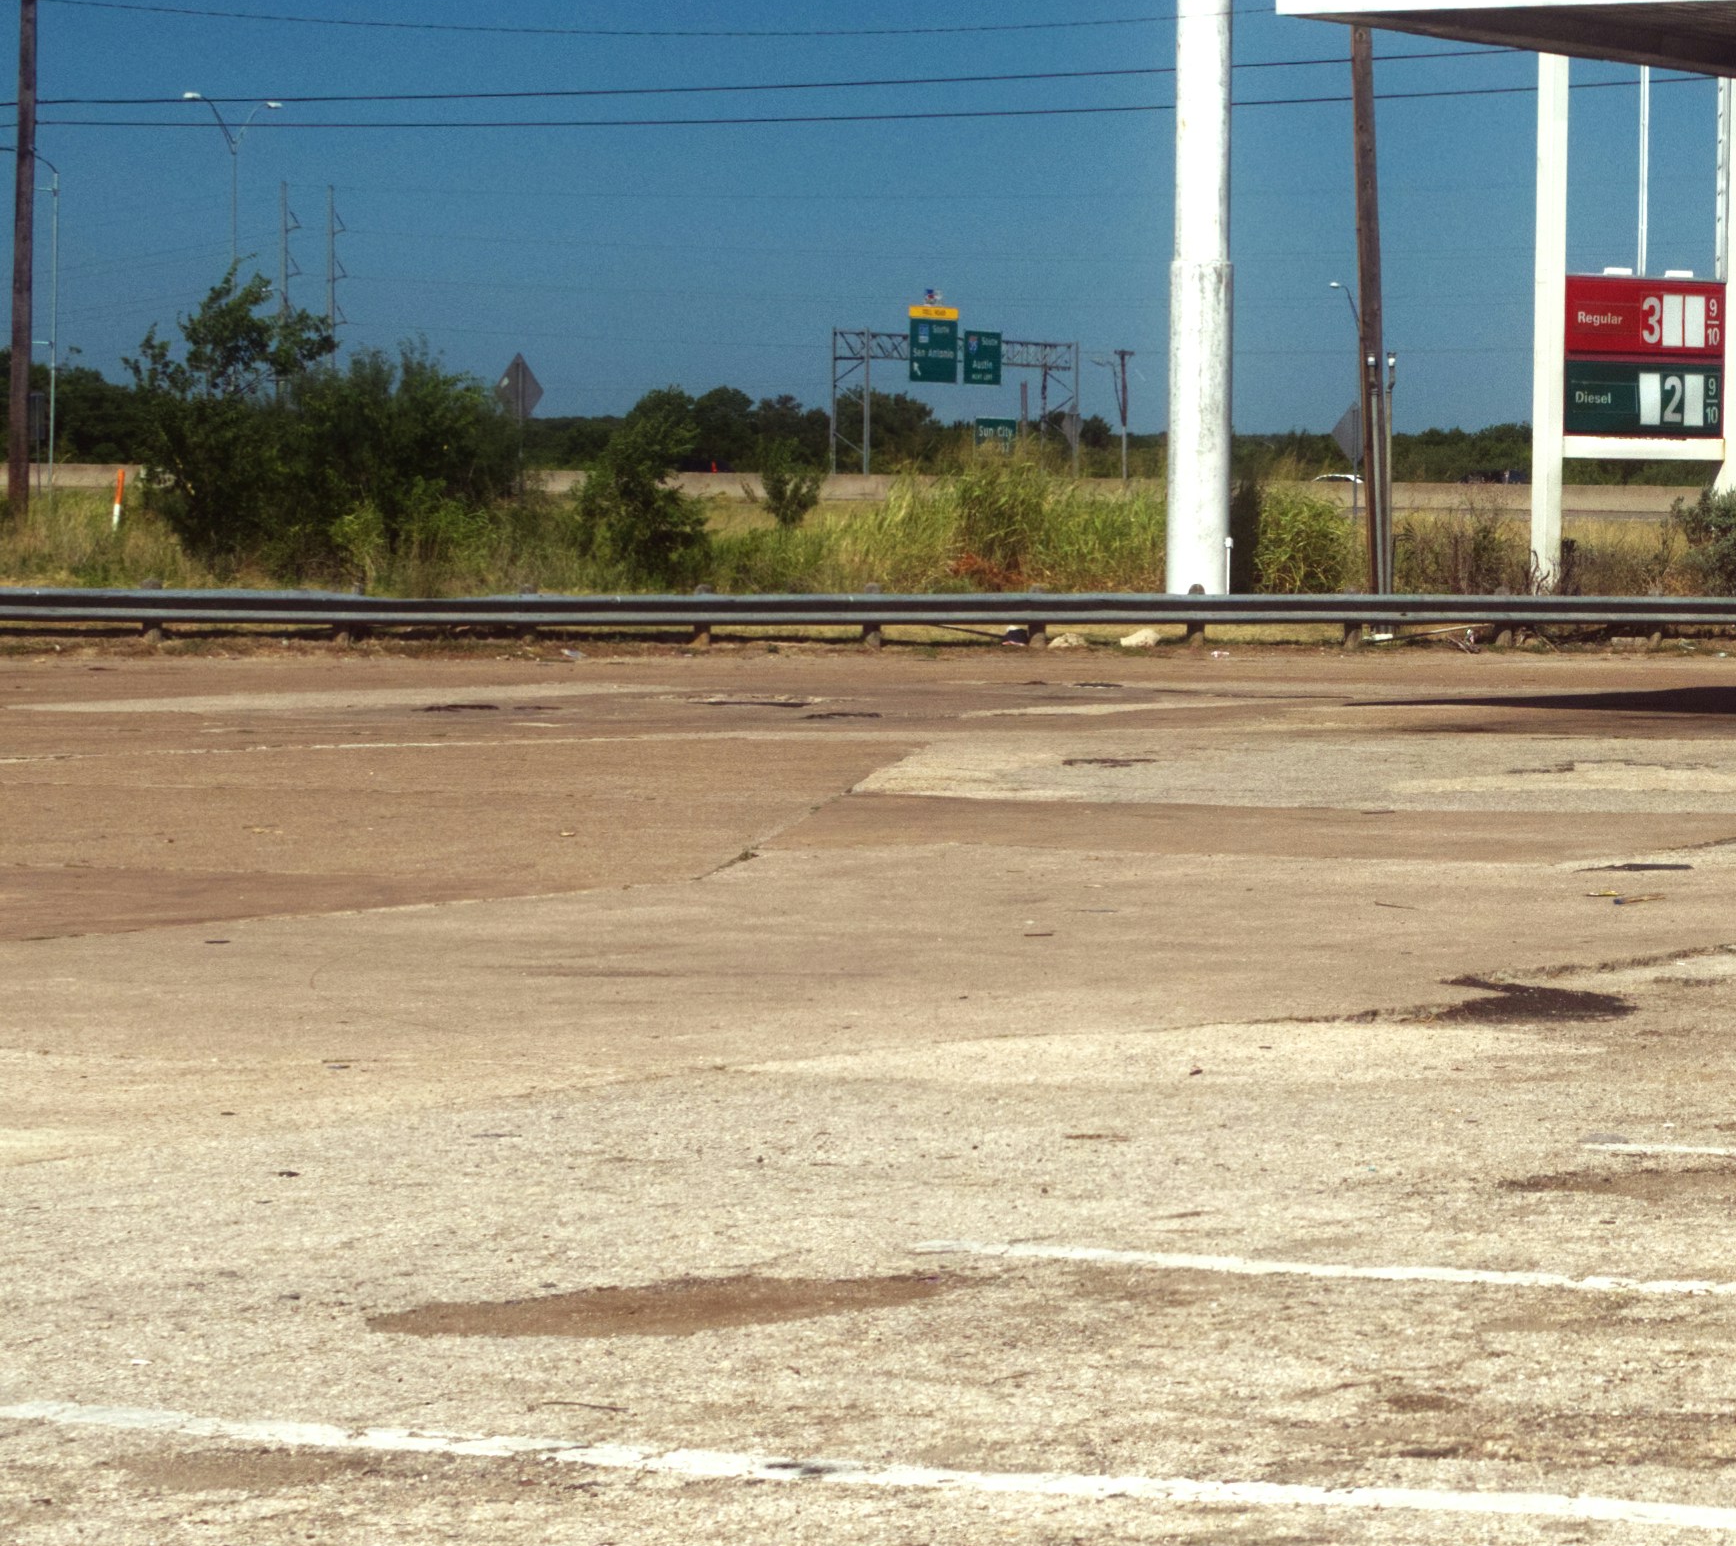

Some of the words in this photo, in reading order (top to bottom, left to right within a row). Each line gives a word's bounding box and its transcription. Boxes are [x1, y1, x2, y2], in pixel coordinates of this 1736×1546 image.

[1709, 299, 1718, 317] 9
[1577, 311, 1623, 326] Regular
[1642, 296, 1661, 344] 3
[932, 325, 950, 334] South
[1707, 327, 1720, 345] 10
[981, 337, 998, 346] South
[913, 349, 926, 357] San
[928, 349, 955, 359] Antonio
[972, 360, 993, 369] Austin
[1708, 378, 1717, 396] 9
[1575, 391, 1612, 404] Diesel
[1663, 375, 1683, 423] 2
[1705, 406, 1719, 424] 10
[978, 425, 994, 437] Sun
[997, 426, 1013, 441] City
